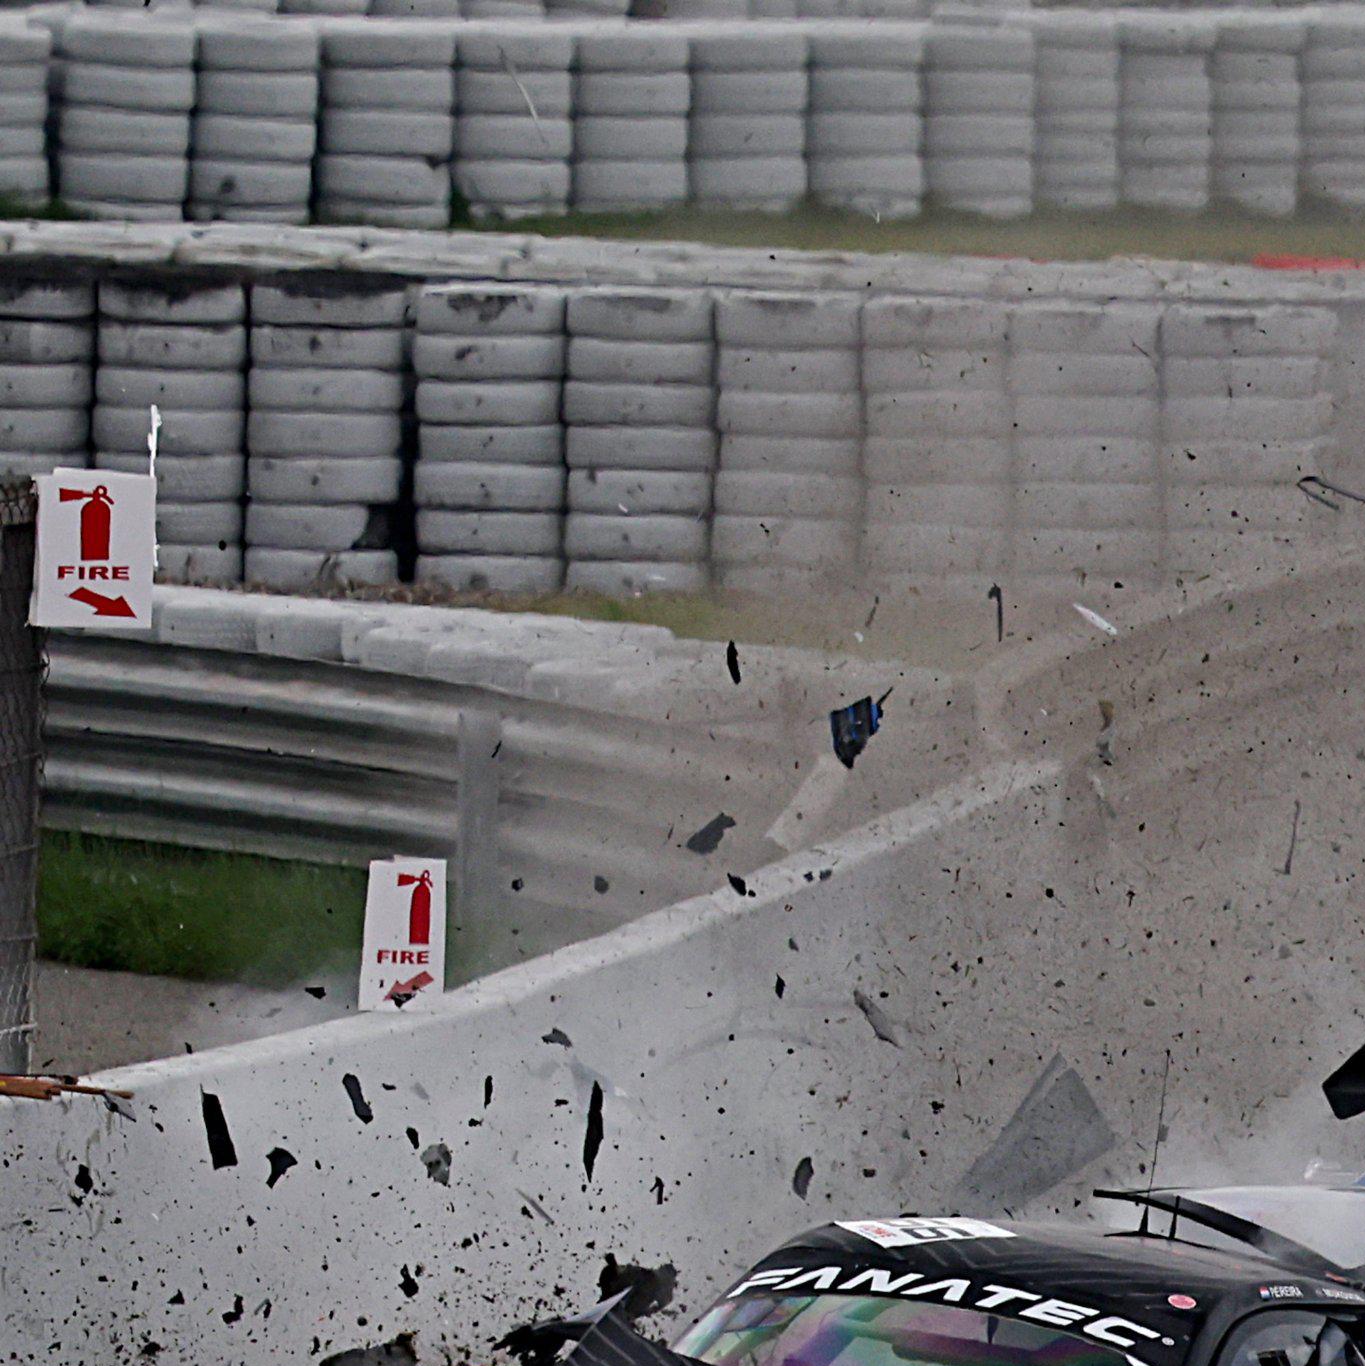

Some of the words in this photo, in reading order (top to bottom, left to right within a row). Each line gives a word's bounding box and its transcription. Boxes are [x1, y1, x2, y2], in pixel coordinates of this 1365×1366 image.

[57, 565, 130, 581] FIRE
[376, 949, 430, 965] FIRE
[726, 1266, 1161, 1348] FANATEC
